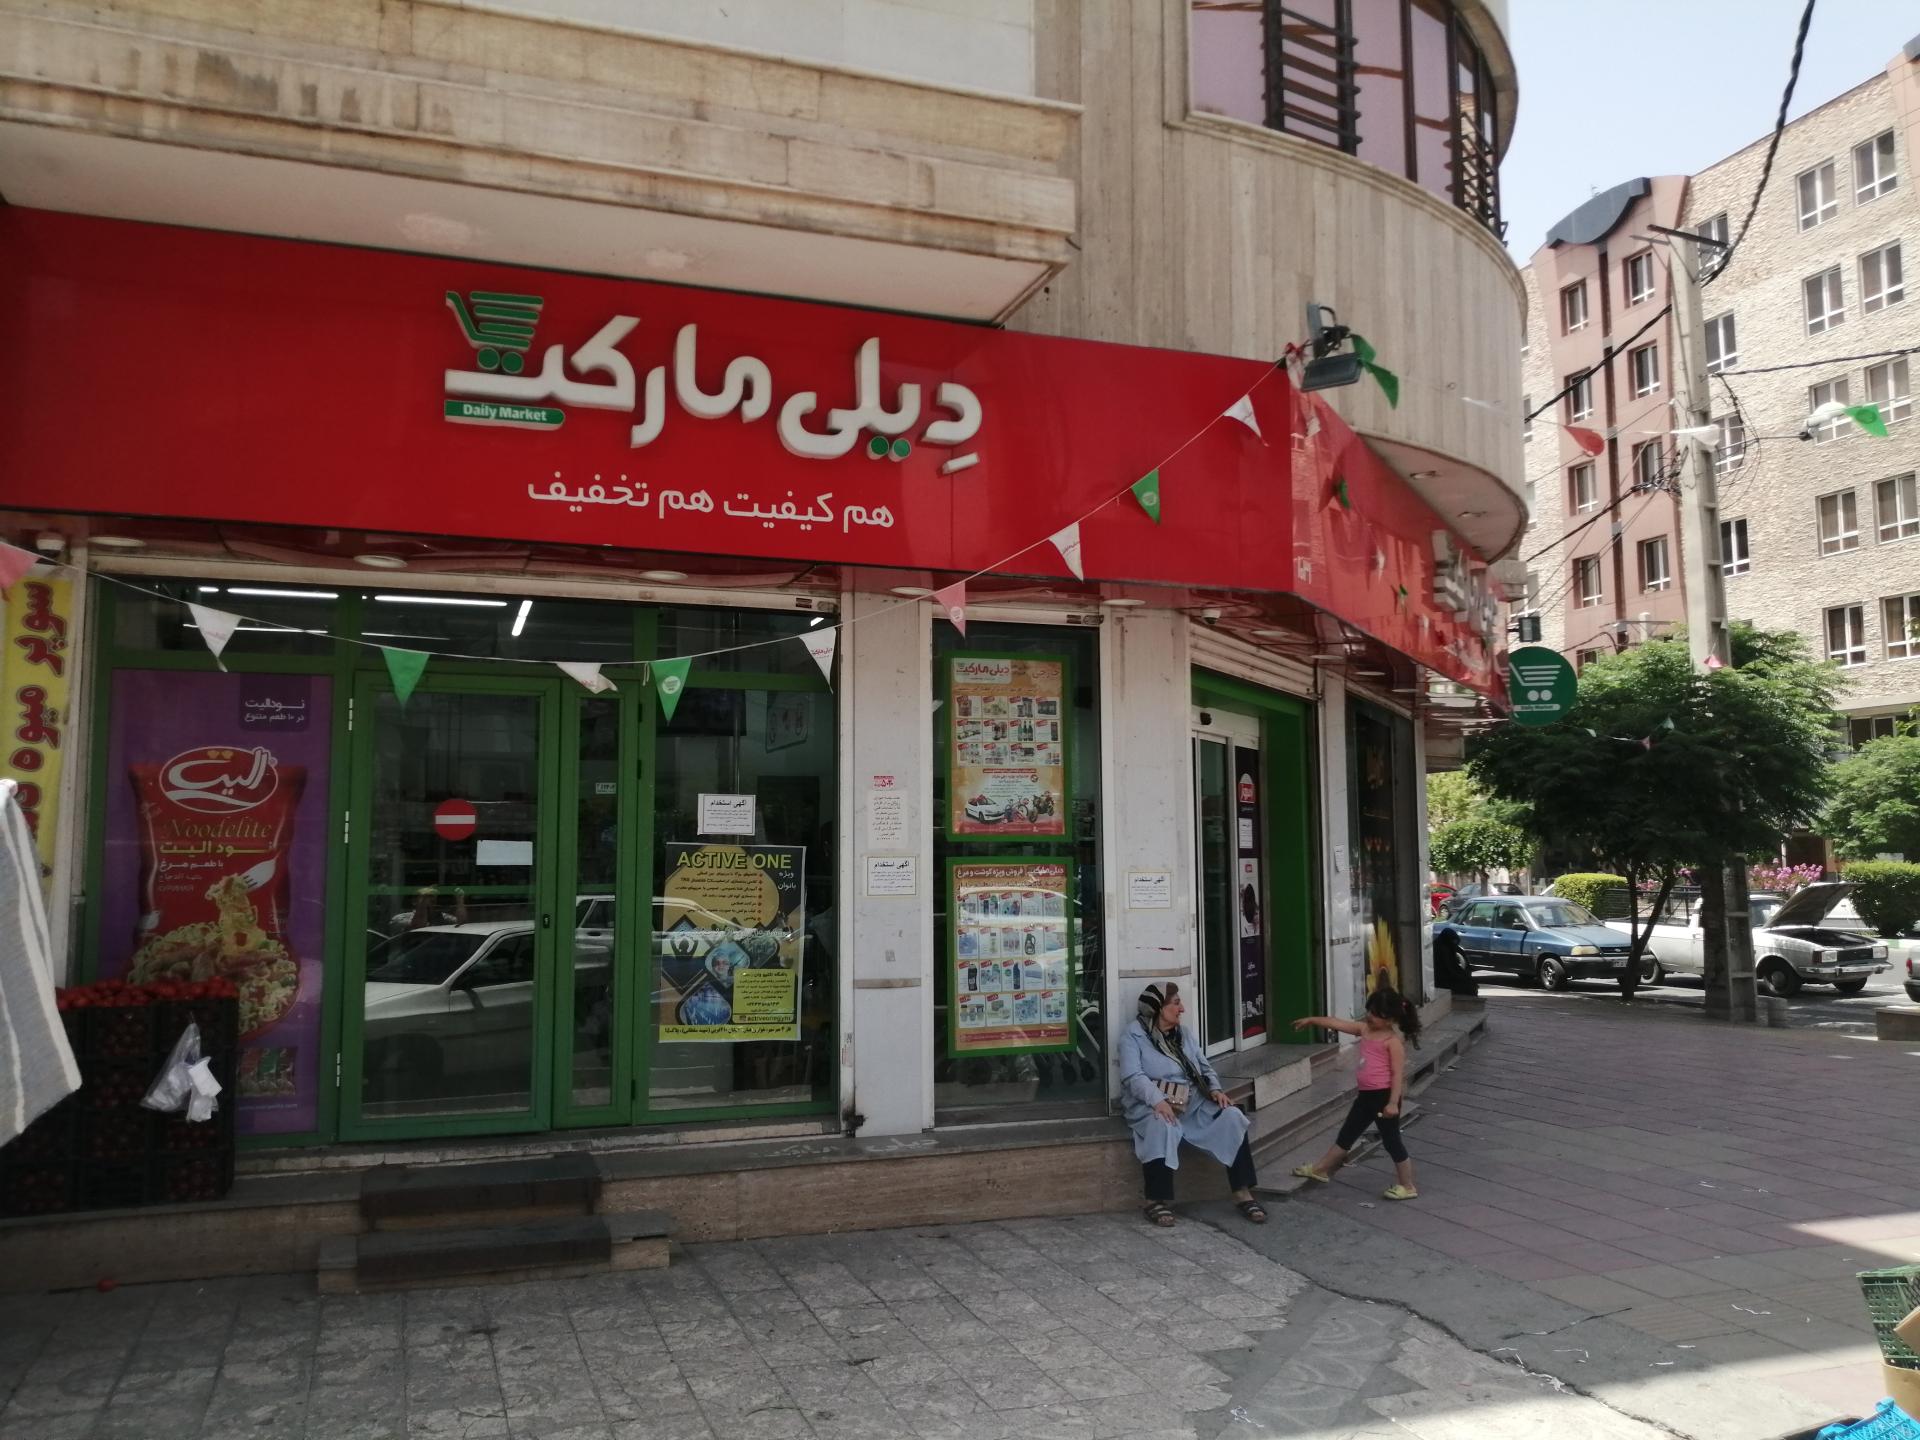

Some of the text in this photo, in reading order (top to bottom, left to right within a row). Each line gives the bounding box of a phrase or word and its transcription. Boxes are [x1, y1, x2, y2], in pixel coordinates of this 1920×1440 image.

[444, 313, 772, 449] مارکت
[463, 403, 548, 422] Daily Market
[527, 470, 895, 534] هم کیفیت هم تخفیف
[15, 581, 69, 678] سوپر
[9, 684, 61, 773] میوه
[677, 851, 792, 870] ACTIVE ONE
